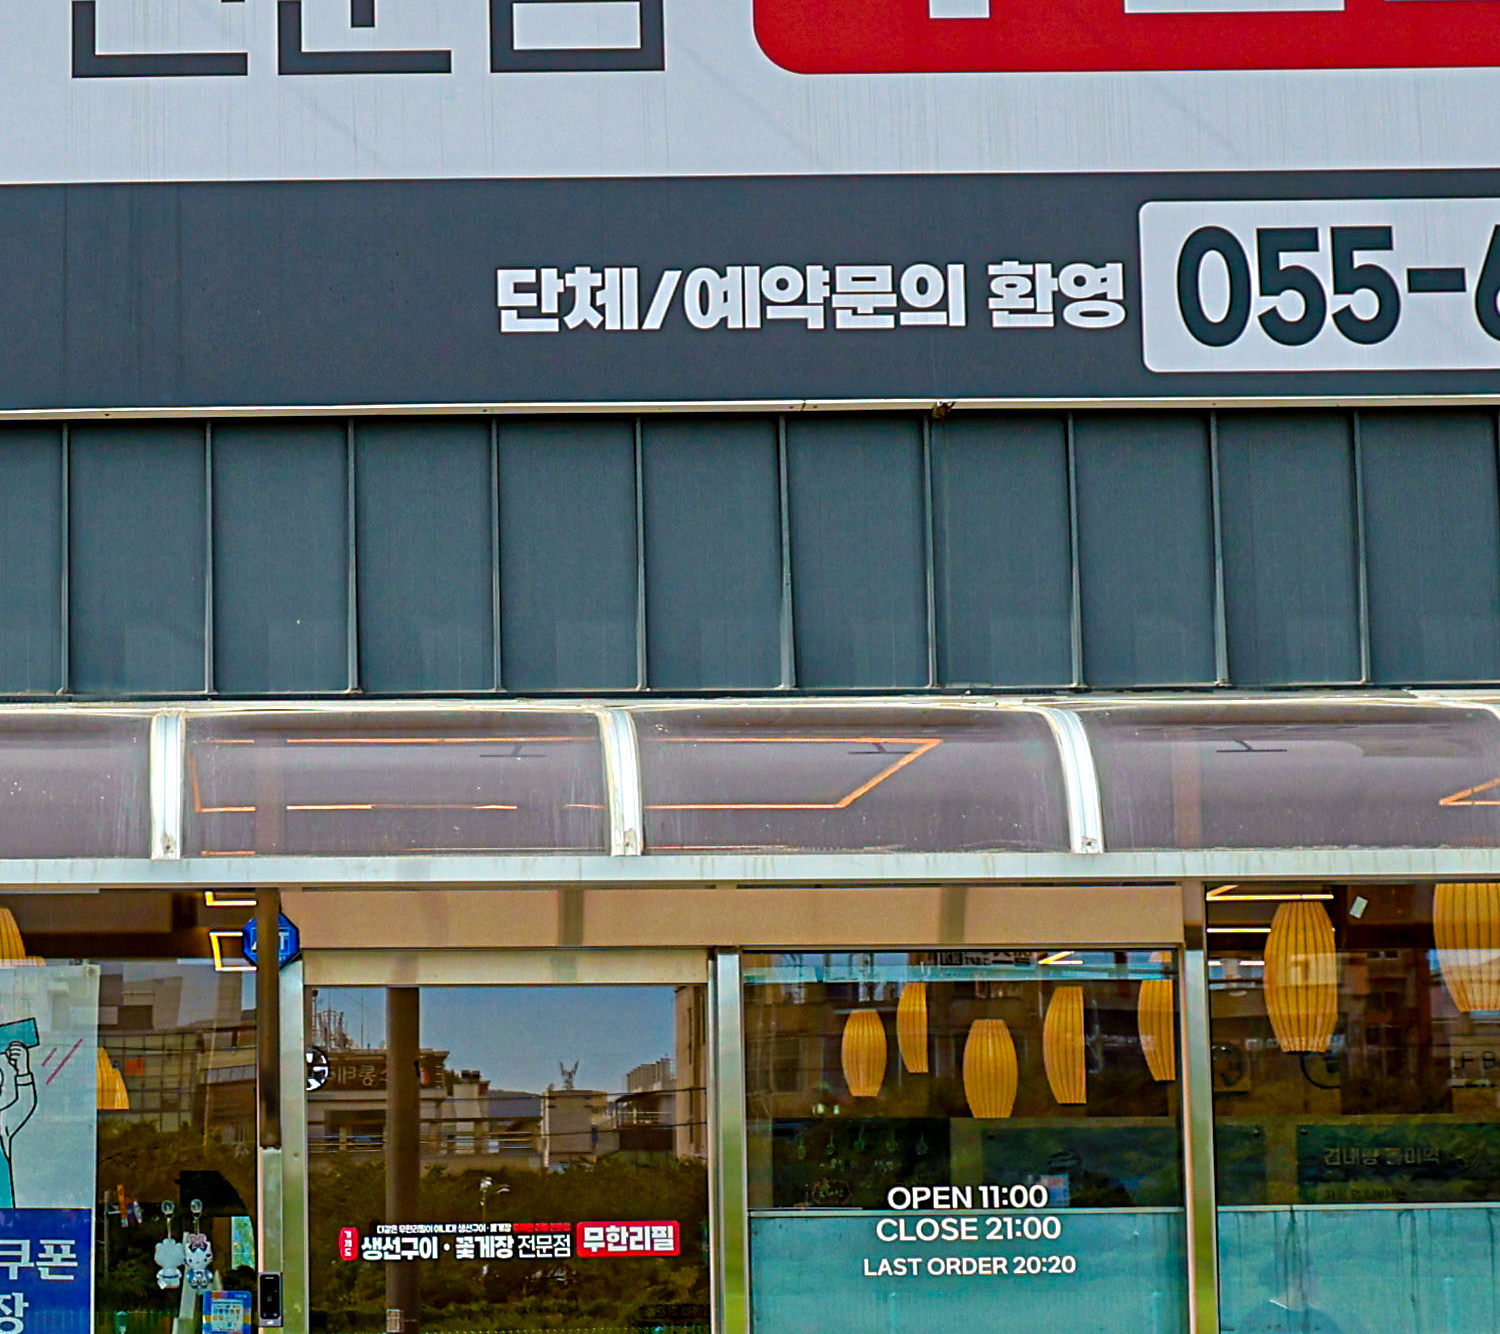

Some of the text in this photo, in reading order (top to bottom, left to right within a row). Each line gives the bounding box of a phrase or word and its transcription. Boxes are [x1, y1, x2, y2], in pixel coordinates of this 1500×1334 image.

[497, 259, 1124, 335] 단체/예약문의 환영
[887, 1184, 1048, 1210] OPEN 11:00
[583, 1225, 675, 1252] 무한리필
[876, 1215, 1061, 1242] CLOSE 21:00
[361, 1237, 438, 1260] 생선구이
[455, 1236, 514, 1259] 꽃게장
[518, 1236, 571, 1257] 전문점
[864, 1255, 1076, 1277] LAST ORDER 20:20
